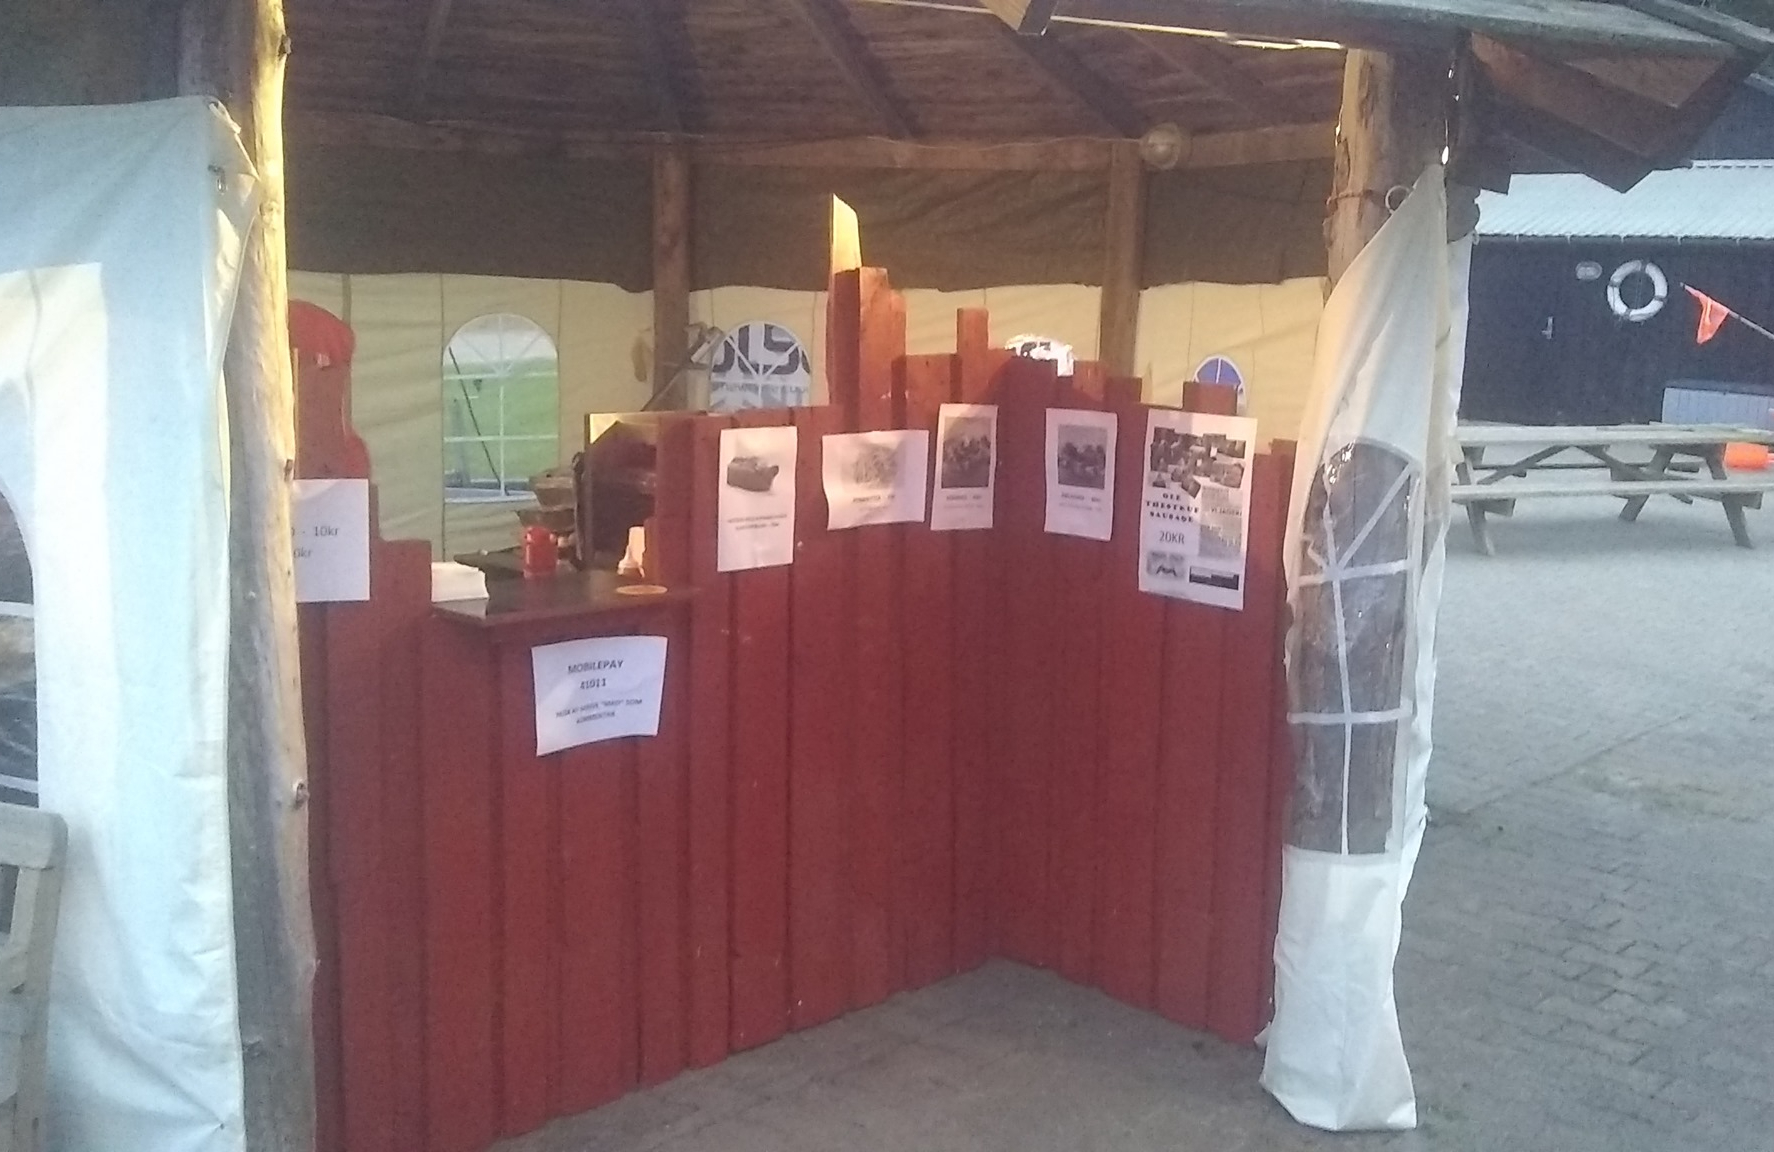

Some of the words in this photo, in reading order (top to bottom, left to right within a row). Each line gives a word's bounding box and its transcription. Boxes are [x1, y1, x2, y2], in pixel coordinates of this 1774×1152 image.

[314, 525, 339, 536] 10kr
[1159, 530, 1185, 545] 20KR
[568, 660, 624, 673] MOBILEPAY
